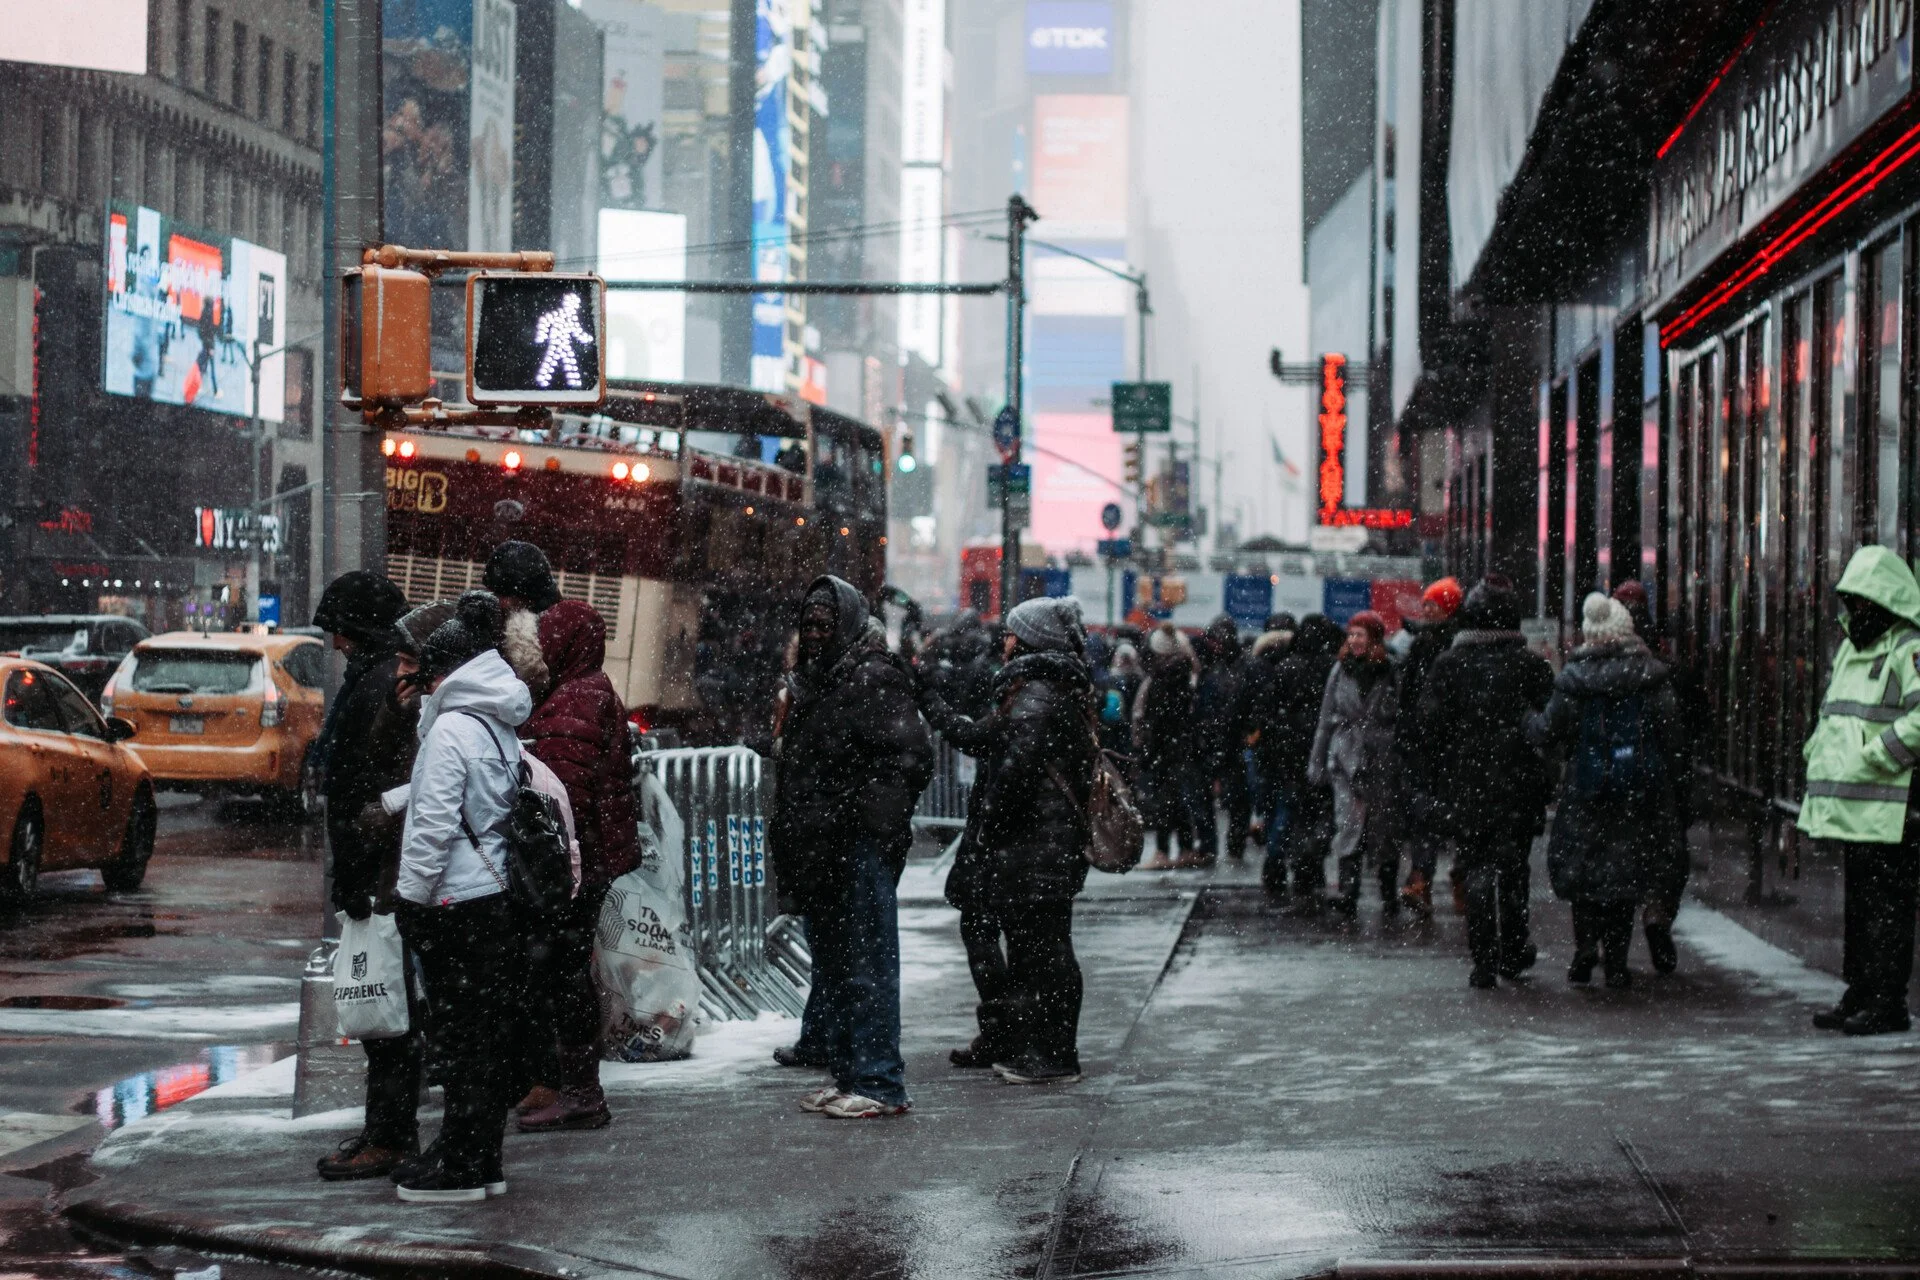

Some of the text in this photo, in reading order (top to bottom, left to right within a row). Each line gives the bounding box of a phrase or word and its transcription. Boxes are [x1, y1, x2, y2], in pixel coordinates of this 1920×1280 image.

[1052, 27, 1108, 48] TDK
[692, 840, 702, 904] NYPD
[707, 823, 716, 886] NYPD
[729, 818, 739, 881] NYPD
[742, 821, 752, 884] NYPD
[755, 819, 763, 882] NYPD
[333, 983, 388, 1000] EXPERIENCE
